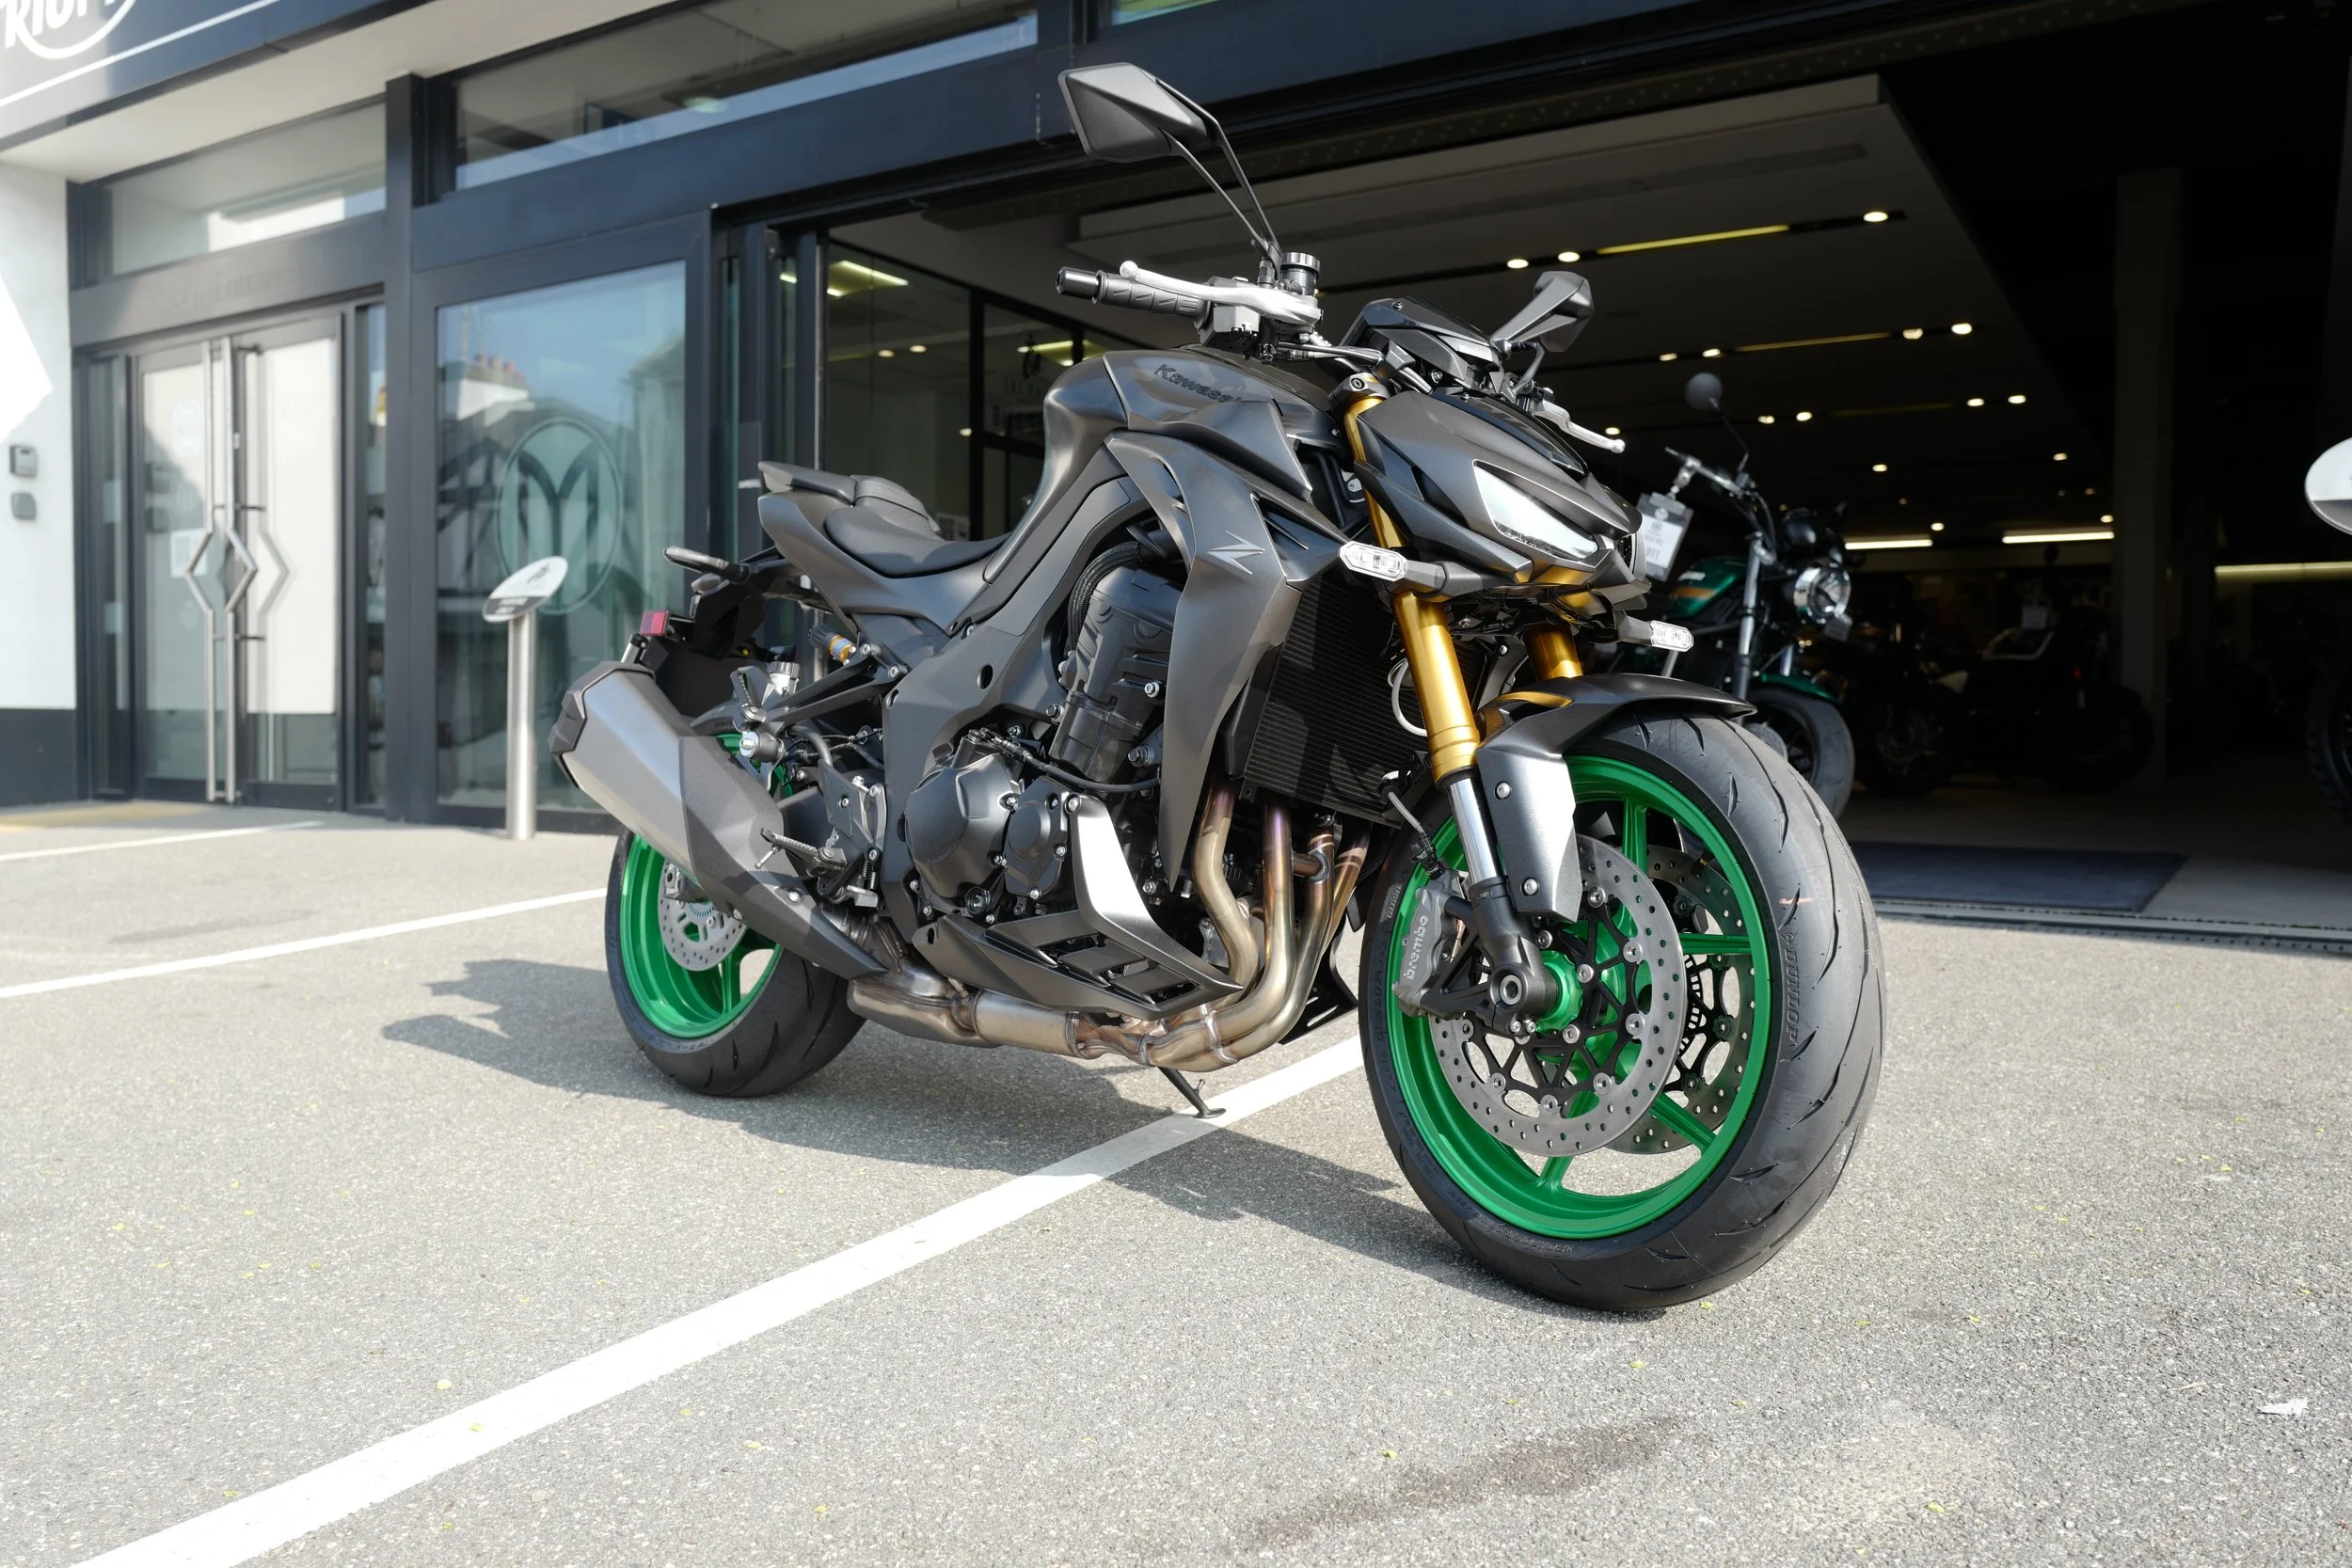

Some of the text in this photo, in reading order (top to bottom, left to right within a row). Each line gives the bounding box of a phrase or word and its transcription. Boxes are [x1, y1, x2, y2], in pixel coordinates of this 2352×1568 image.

[1153, 363, 1243, 404] Kawasa
[1403, 915, 1429, 980] brembo
[1784, 947, 1801, 1043] DUNLOP
